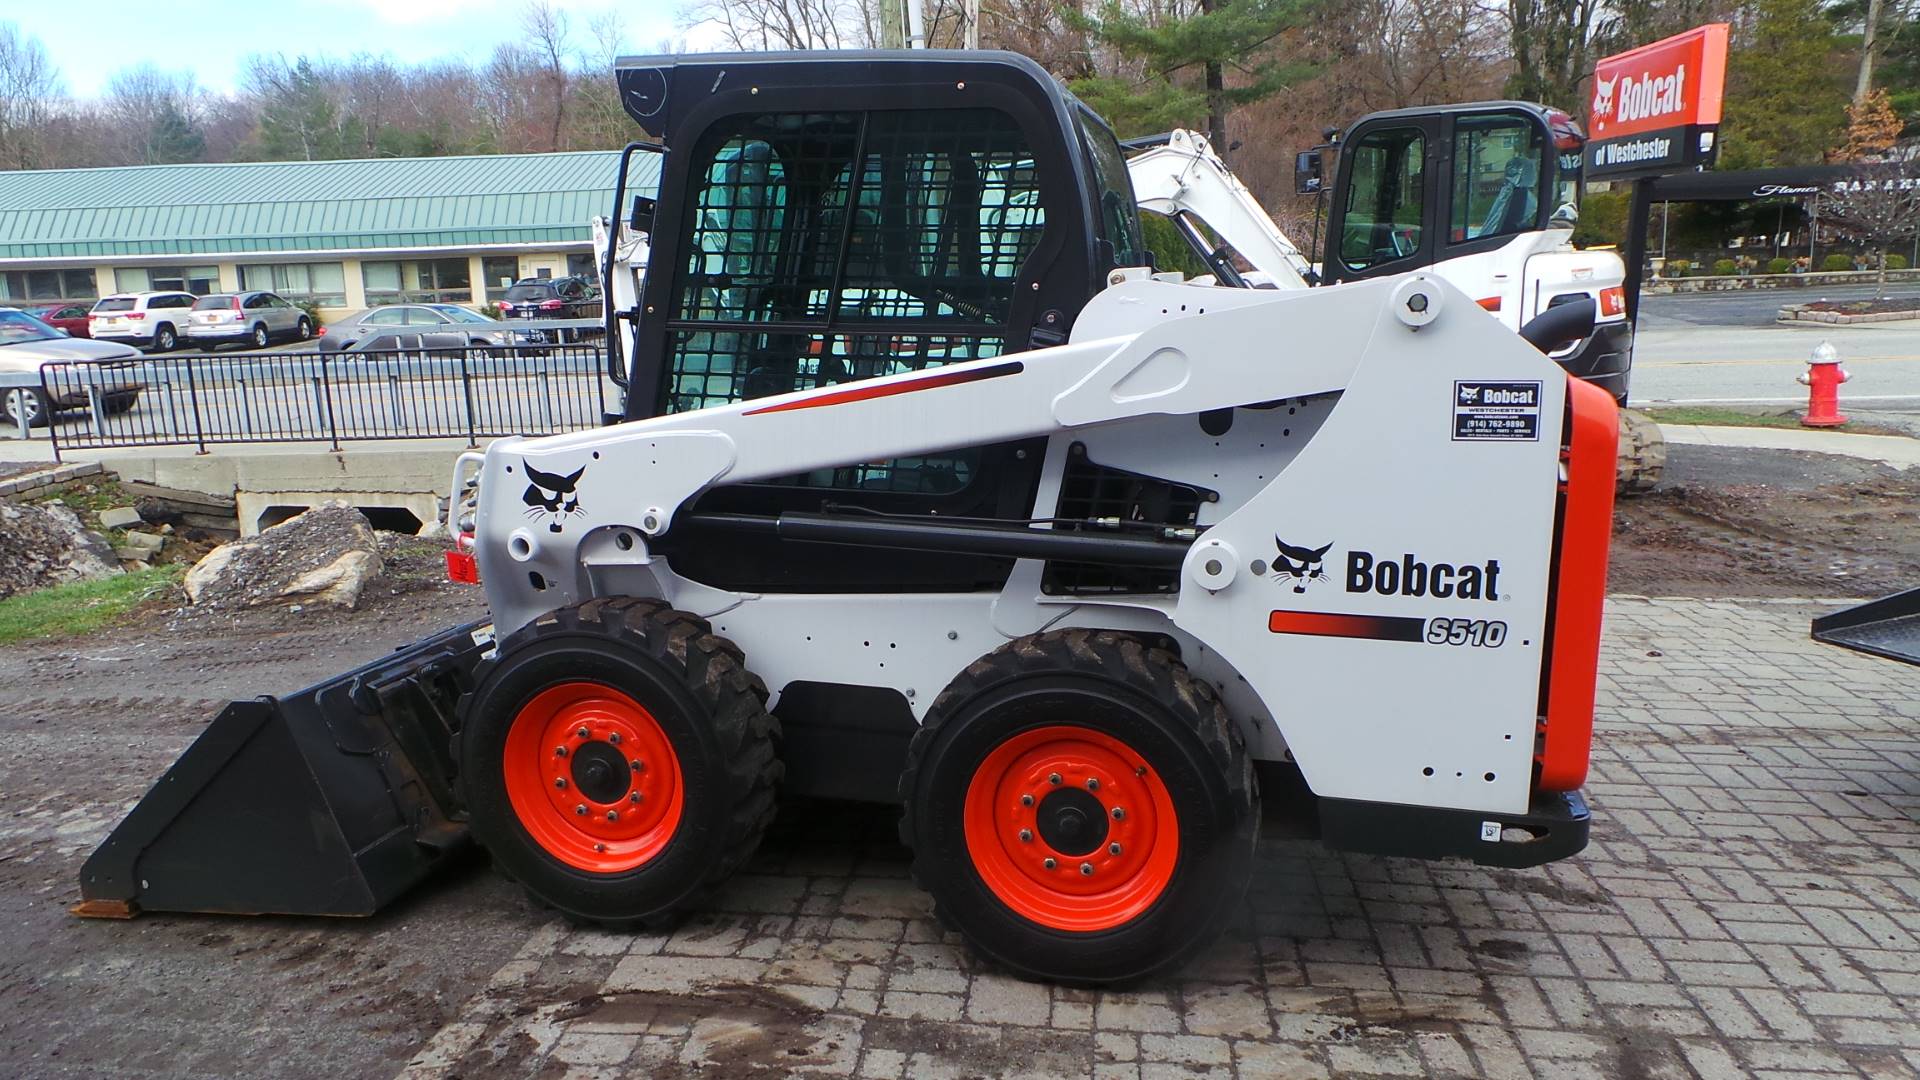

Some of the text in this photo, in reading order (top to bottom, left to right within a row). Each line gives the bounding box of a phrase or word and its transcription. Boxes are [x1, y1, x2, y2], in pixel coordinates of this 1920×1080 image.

[1617, 64, 1685, 123] Bobcat
[1595, 146, 1606, 166] of
[1606, 137, 1671, 165] Westchester
[1753, 184, 1819, 197] Flames
[1484, 389, 1534, 404] Bobcat
[1467, 420, 1487, 428] (914)
[1346, 551, 1500, 601] Bobcat
[1427, 617, 1507, 648] S510
